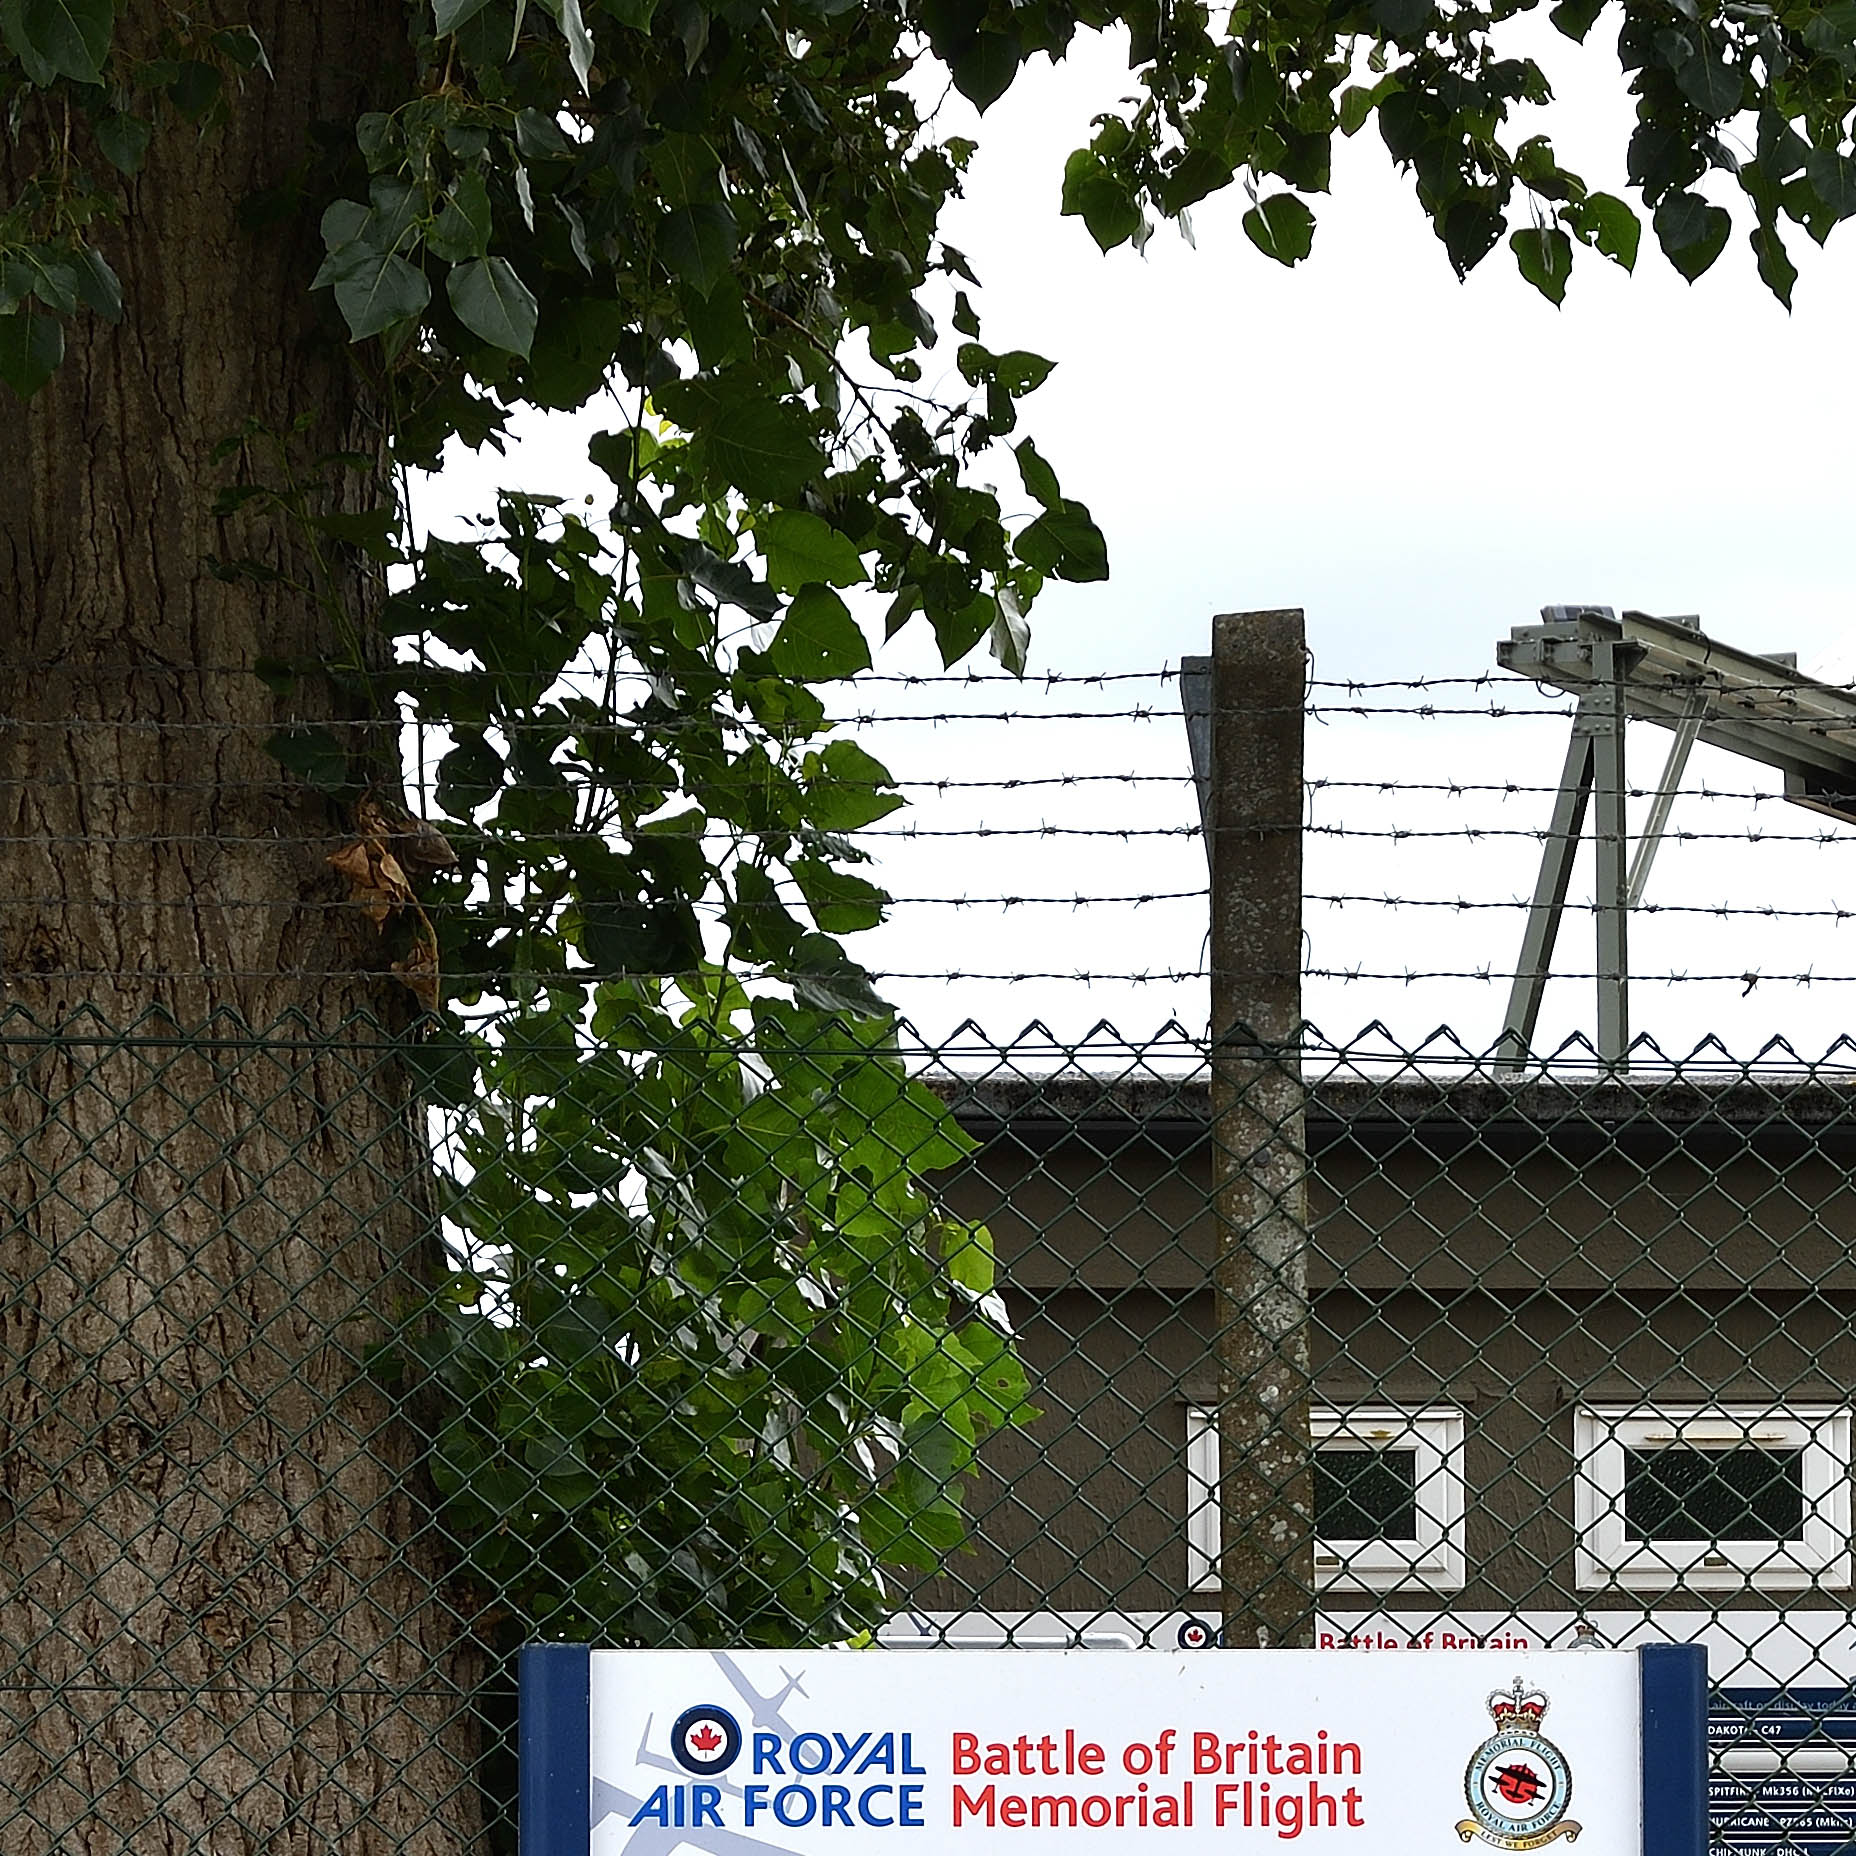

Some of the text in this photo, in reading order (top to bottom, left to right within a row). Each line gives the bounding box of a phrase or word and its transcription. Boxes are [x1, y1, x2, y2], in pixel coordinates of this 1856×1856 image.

[1442, 1631, 1529, 1650] Briain
[1707, 1724, 1782, 1736] DAKOT C47
[752, 1732, 927, 1776] ROYAL
[952, 1728, 1362, 1776] Battle of Britain
[1474, 1737, 1563, 1771] MEMORIAL FLIGHT
[627, 1783, 925, 1828] AIR FORCE
[953, 1780, 1365, 1840] Memorial Flight
[1476, 1800, 1561, 1832] ROYAL AIR FORCE
[1480, 1829, 1559, 1849] LEST WE FORGET
